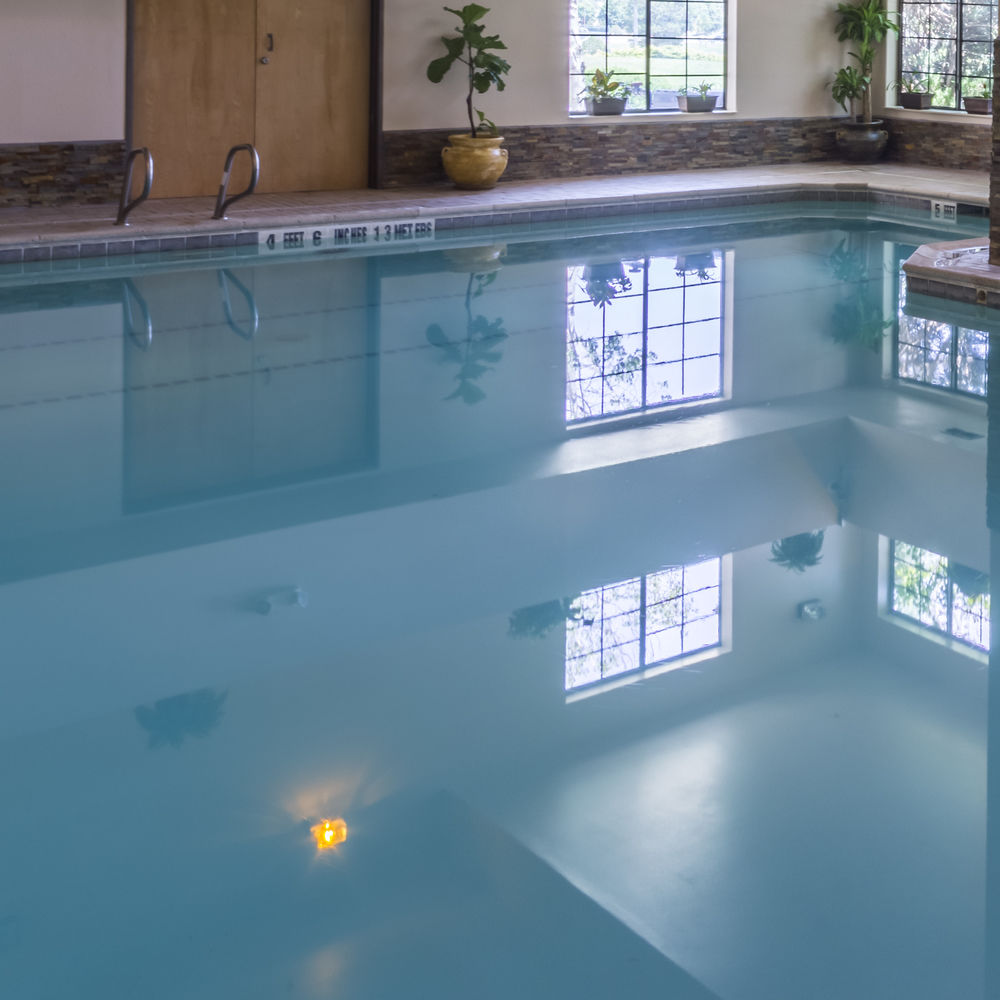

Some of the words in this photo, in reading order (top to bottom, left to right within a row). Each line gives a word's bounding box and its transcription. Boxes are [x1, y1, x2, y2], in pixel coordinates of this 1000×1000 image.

[934, 203, 940, 218] 5
[283, 231, 304, 246] FEET
[312, 230, 322, 245] 6
[335, 227, 367, 243] INCHES
